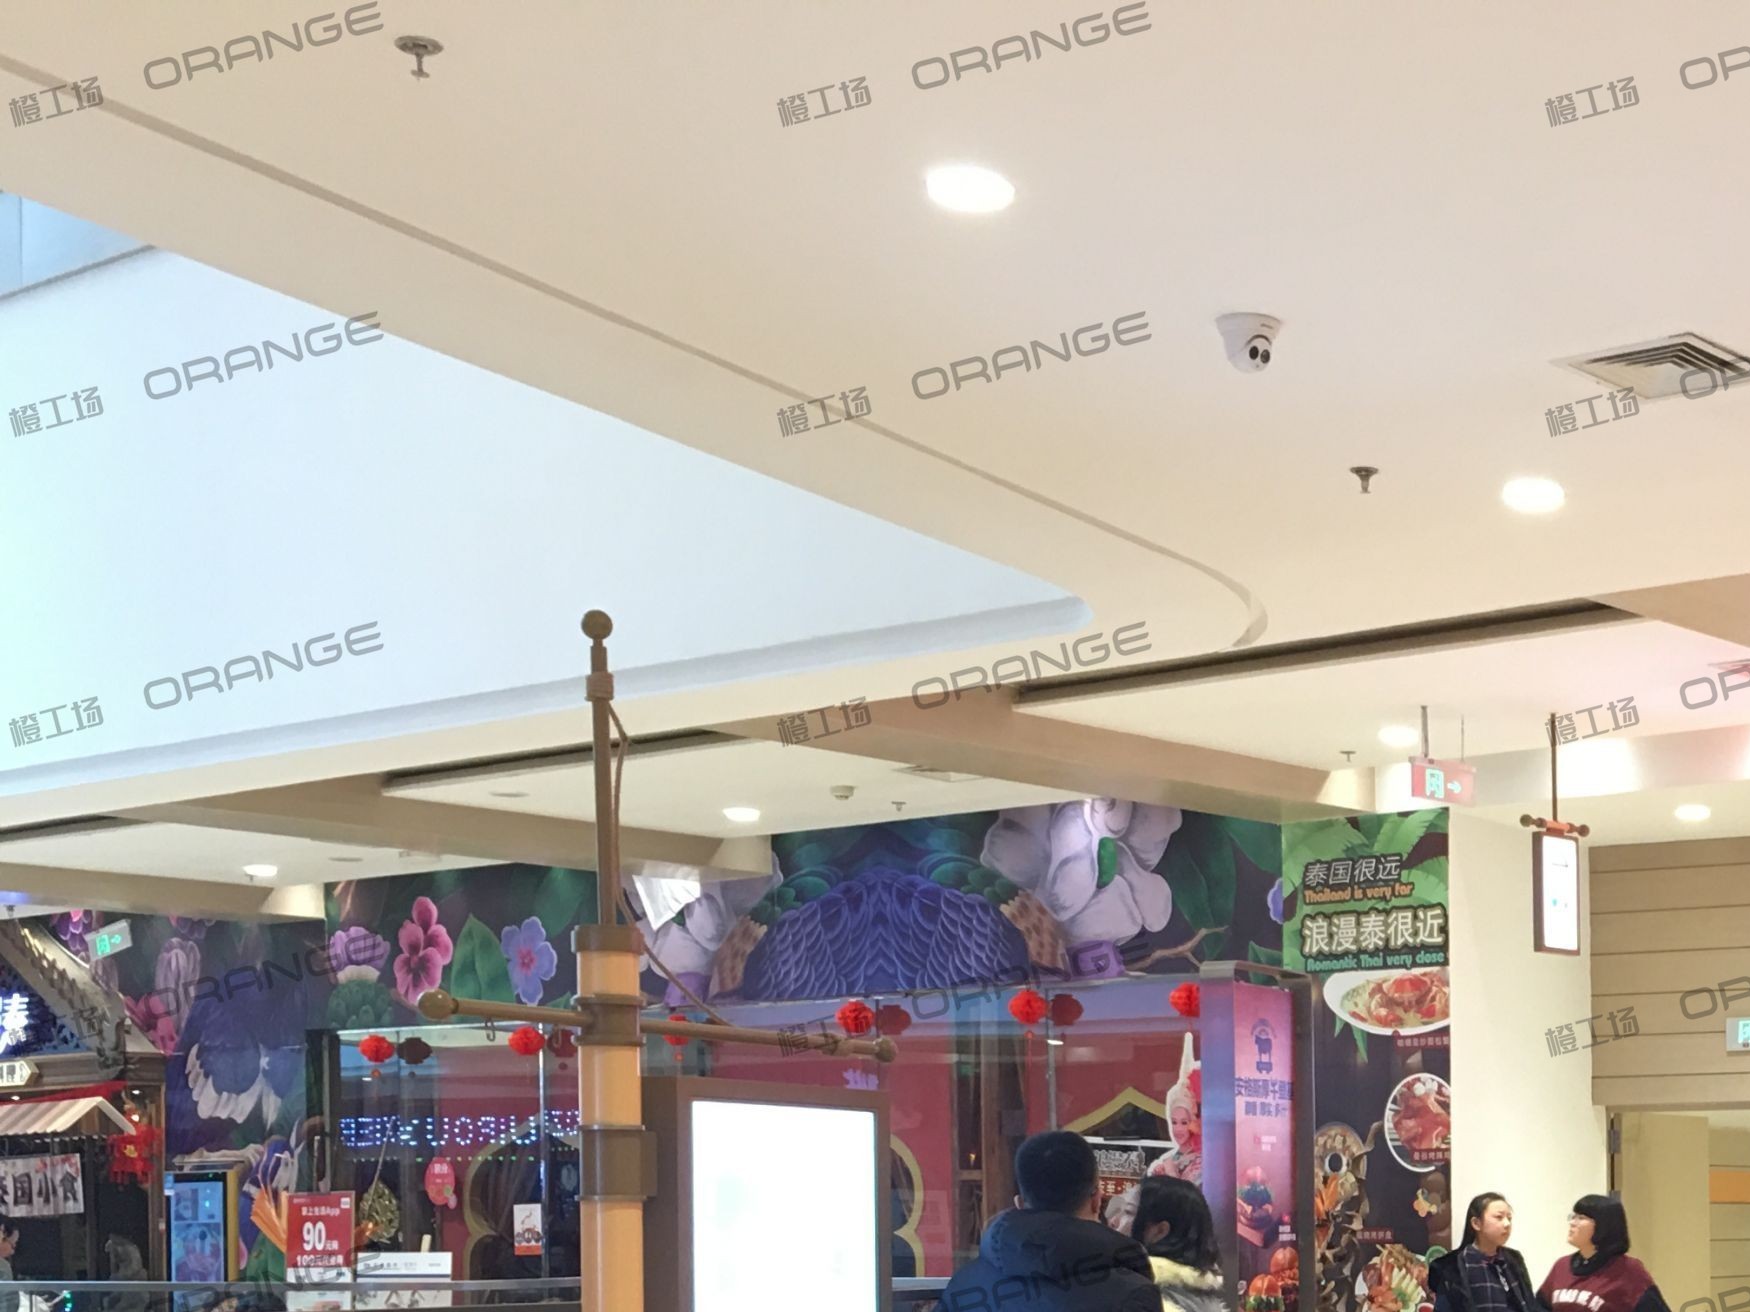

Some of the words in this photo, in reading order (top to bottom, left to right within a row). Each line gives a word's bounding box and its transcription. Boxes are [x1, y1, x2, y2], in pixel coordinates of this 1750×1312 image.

[1305, 856, 1401, 887] 泰国很远
[1305, 887, 1351, 904] Thailand
[1367, 885, 1392, 900] very
[1303, 908, 1444, 954] 浪漫泰很近
[1360, 952, 1383, 968] Thai
[1387, 954, 1412, 968] very
